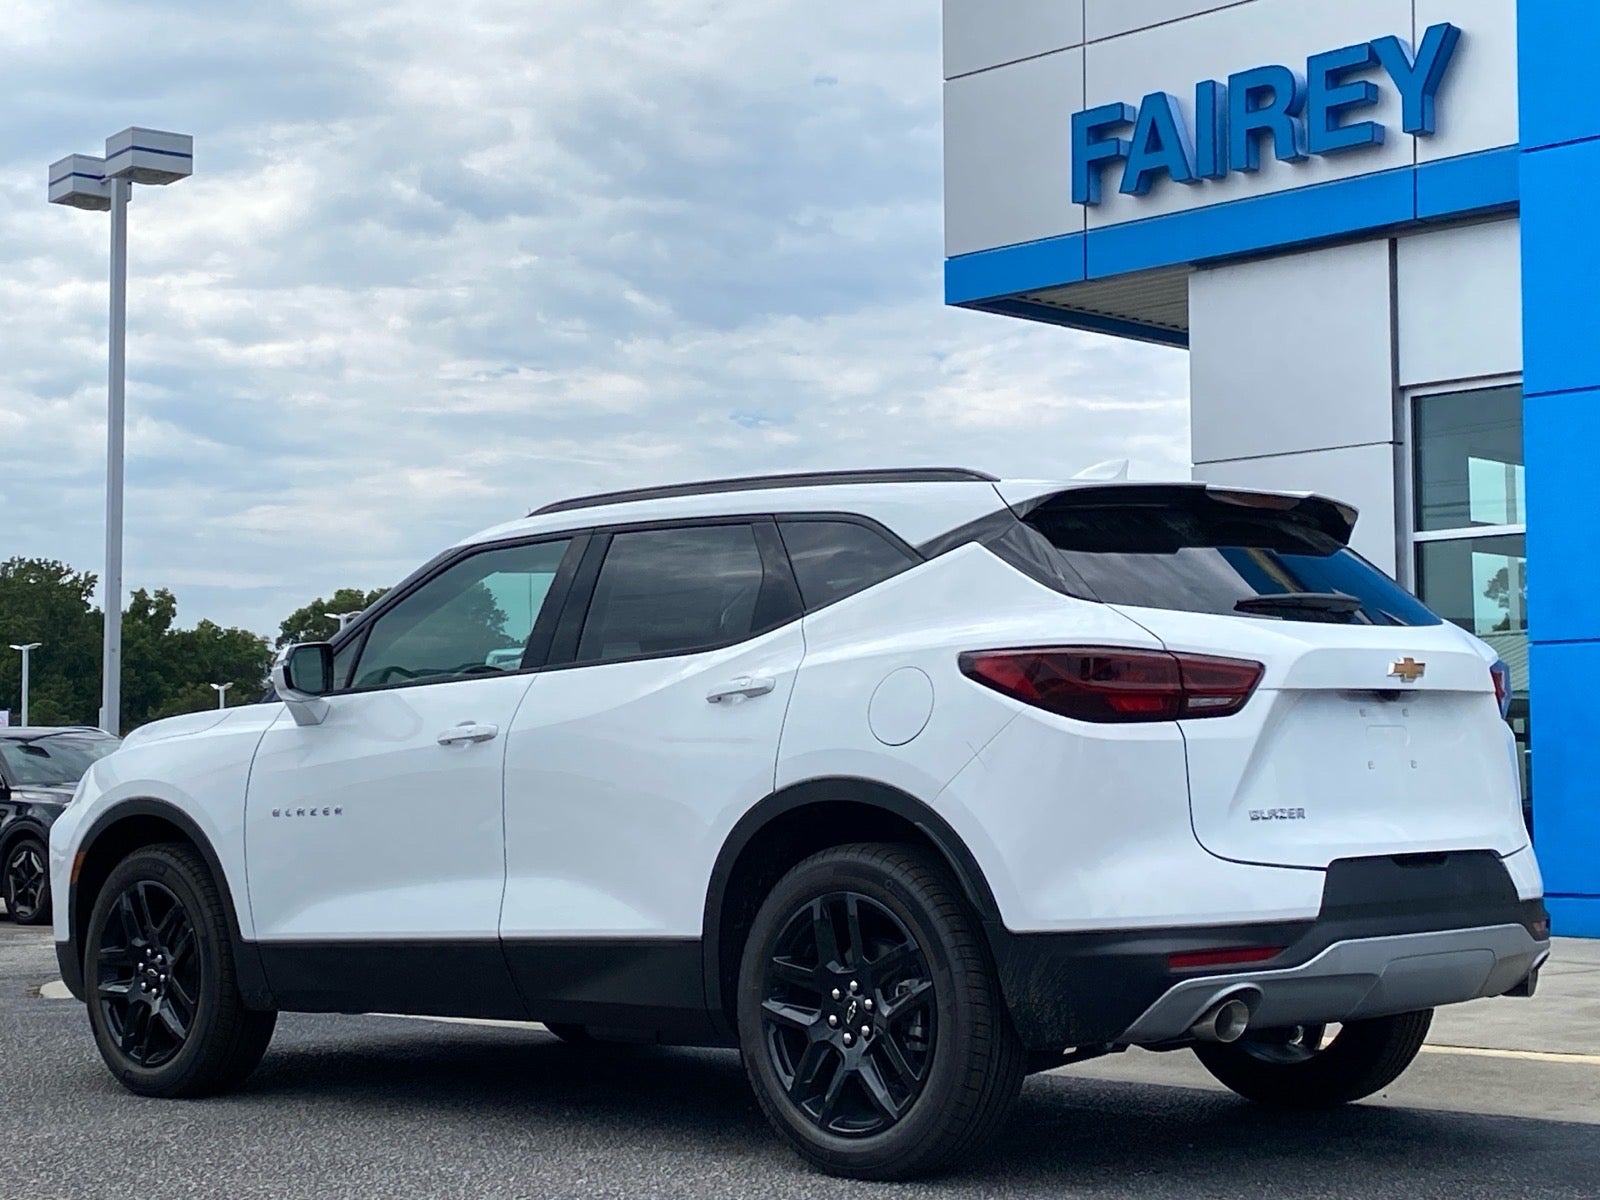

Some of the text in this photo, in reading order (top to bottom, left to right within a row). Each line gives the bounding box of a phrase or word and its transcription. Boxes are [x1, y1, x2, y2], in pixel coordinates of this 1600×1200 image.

[1071, 22, 1461, 206] FAIREY
[272, 807, 343, 818] BLAZER
[1248, 807, 1306, 821] BLAZER
